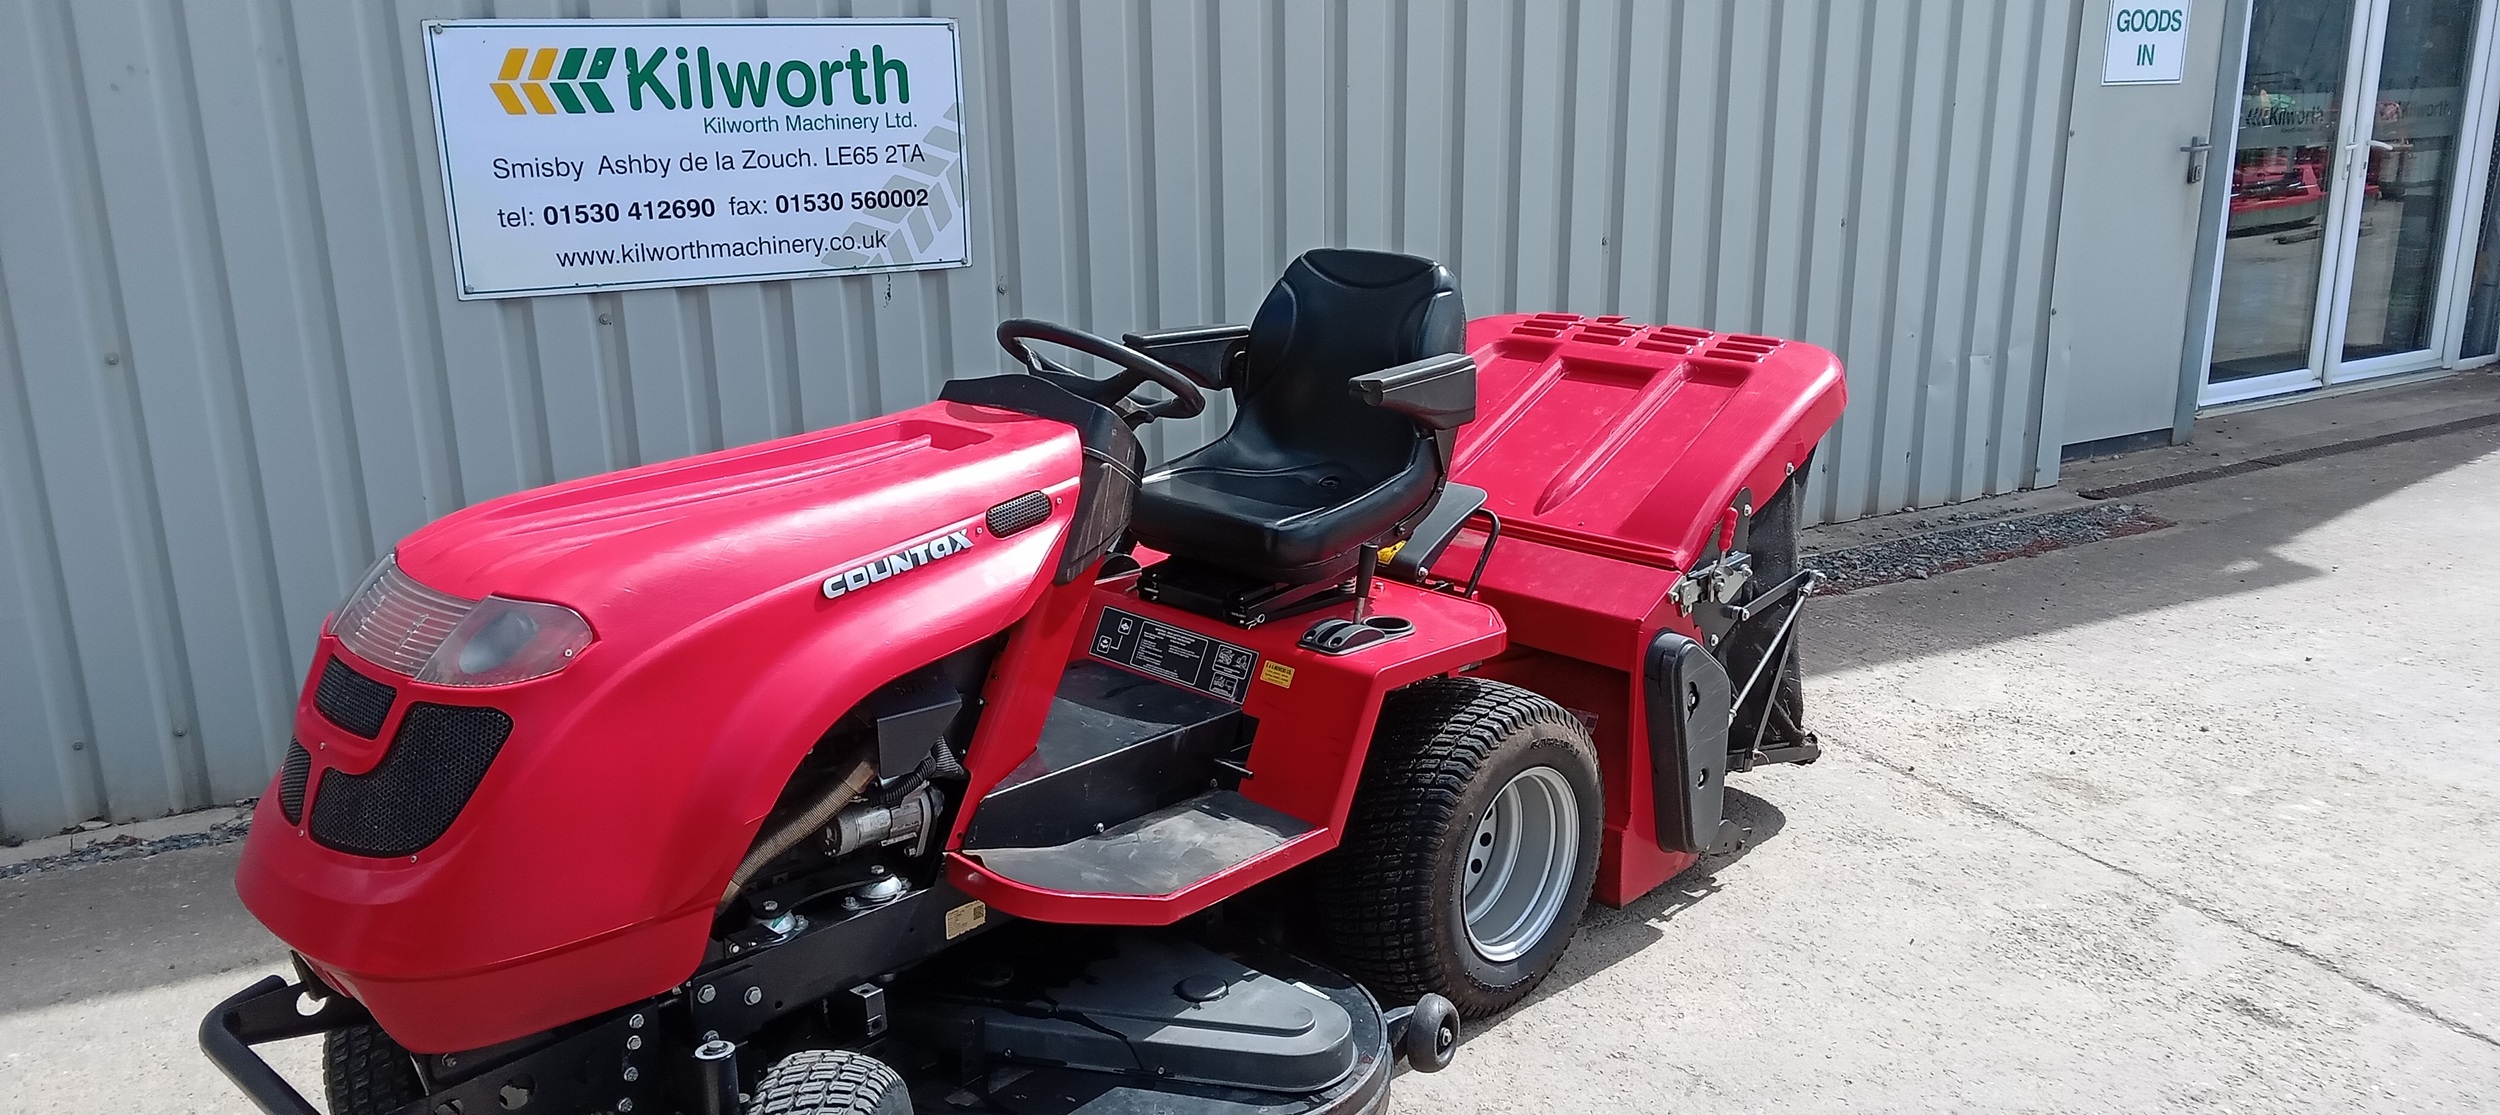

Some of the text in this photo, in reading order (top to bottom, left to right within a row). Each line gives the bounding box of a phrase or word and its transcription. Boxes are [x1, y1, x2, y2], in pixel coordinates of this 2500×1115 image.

[2116, 9, 2183, 33] GOODS
[2136, 43, 2156, 67] IN
[624, 44, 910, 112] Kilworth
[703, 111, 918, 135] Kilworth Machinery Ltd.
[492, 143, 926, 182] Smisby Ashby de la Zouch. LE65 2TA
[496, 188, 929, 228] tel: 01530 412690 fax: 01530 560002
[555, 229, 888, 269] www.kilworthmachinery.co.uk
[822, 527, 975, 599] COUNTAX
